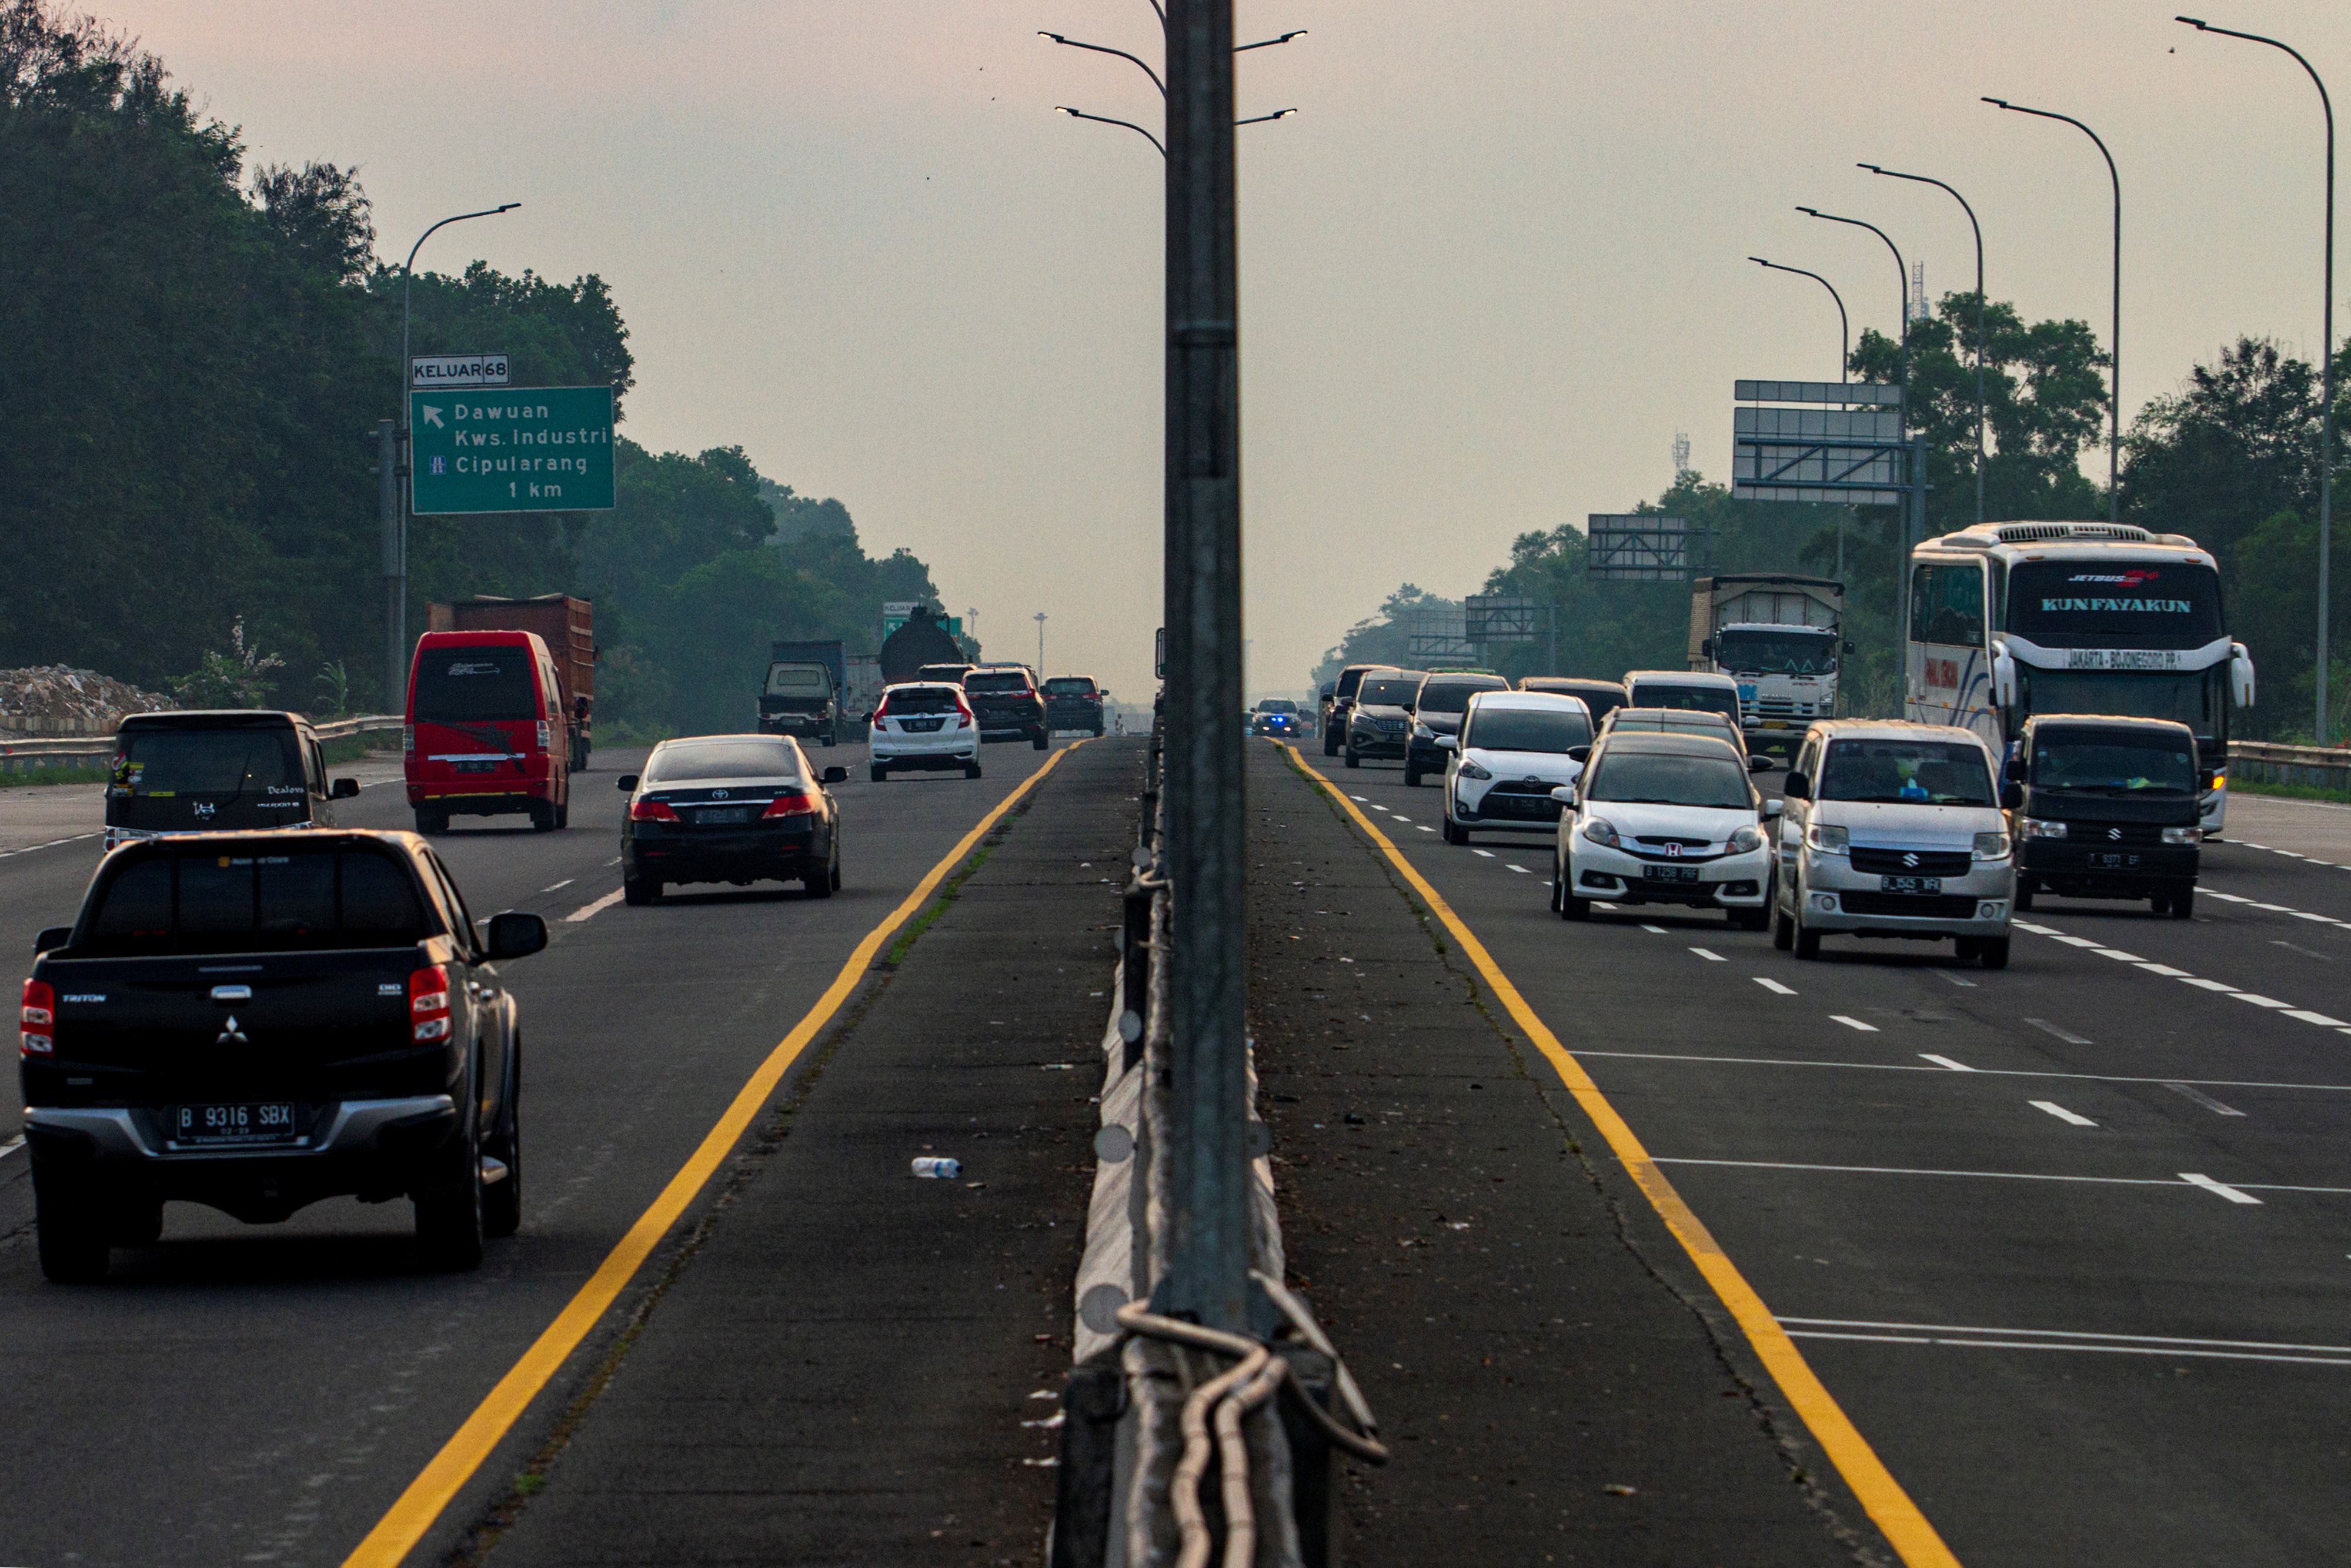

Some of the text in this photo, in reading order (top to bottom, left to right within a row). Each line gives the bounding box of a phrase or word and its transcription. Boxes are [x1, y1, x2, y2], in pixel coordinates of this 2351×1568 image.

[414, 363, 506, 378] KELUAR 68
[455, 404, 548, 420] Dawuan
[455, 427, 607, 446] Kws. Industri
[456, 456, 587, 475] Cipularang
[509, 482, 562, 497] 1 km
[2042, 599, 2192, 613] KUNFAYAKUN
[2069, 650, 2103, 668] JAKARTA
[62, 994, 107, 1002] TRITON
[181, 1105, 290, 1128] B 9316 SBX
